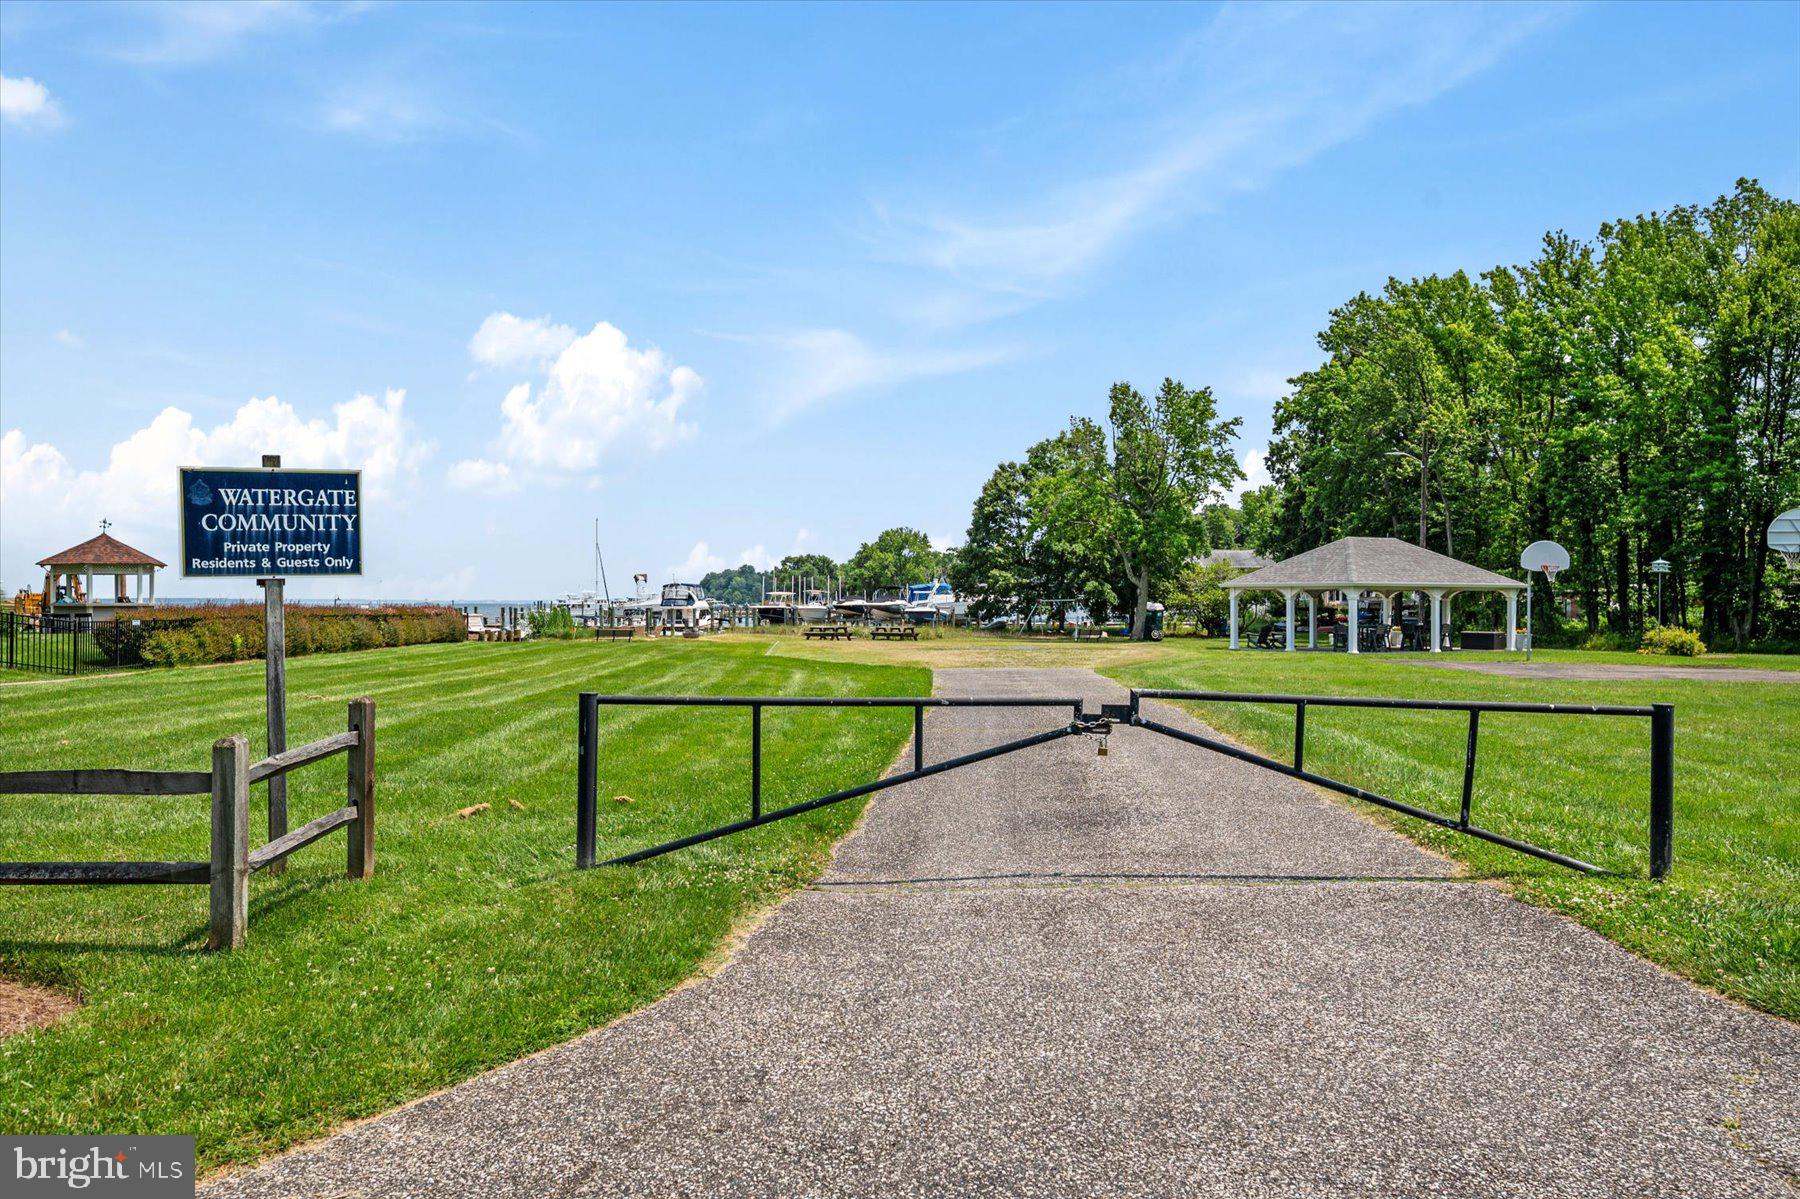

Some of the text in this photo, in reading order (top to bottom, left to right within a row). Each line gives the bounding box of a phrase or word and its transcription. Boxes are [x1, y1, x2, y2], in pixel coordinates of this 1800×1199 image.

[218, 488, 357, 507] WATERGATE
[201, 513, 358, 532] COMMUNITY
[223, 541, 331, 555] Private Property
[192, 556, 354, 569] Residents & Guests Only
